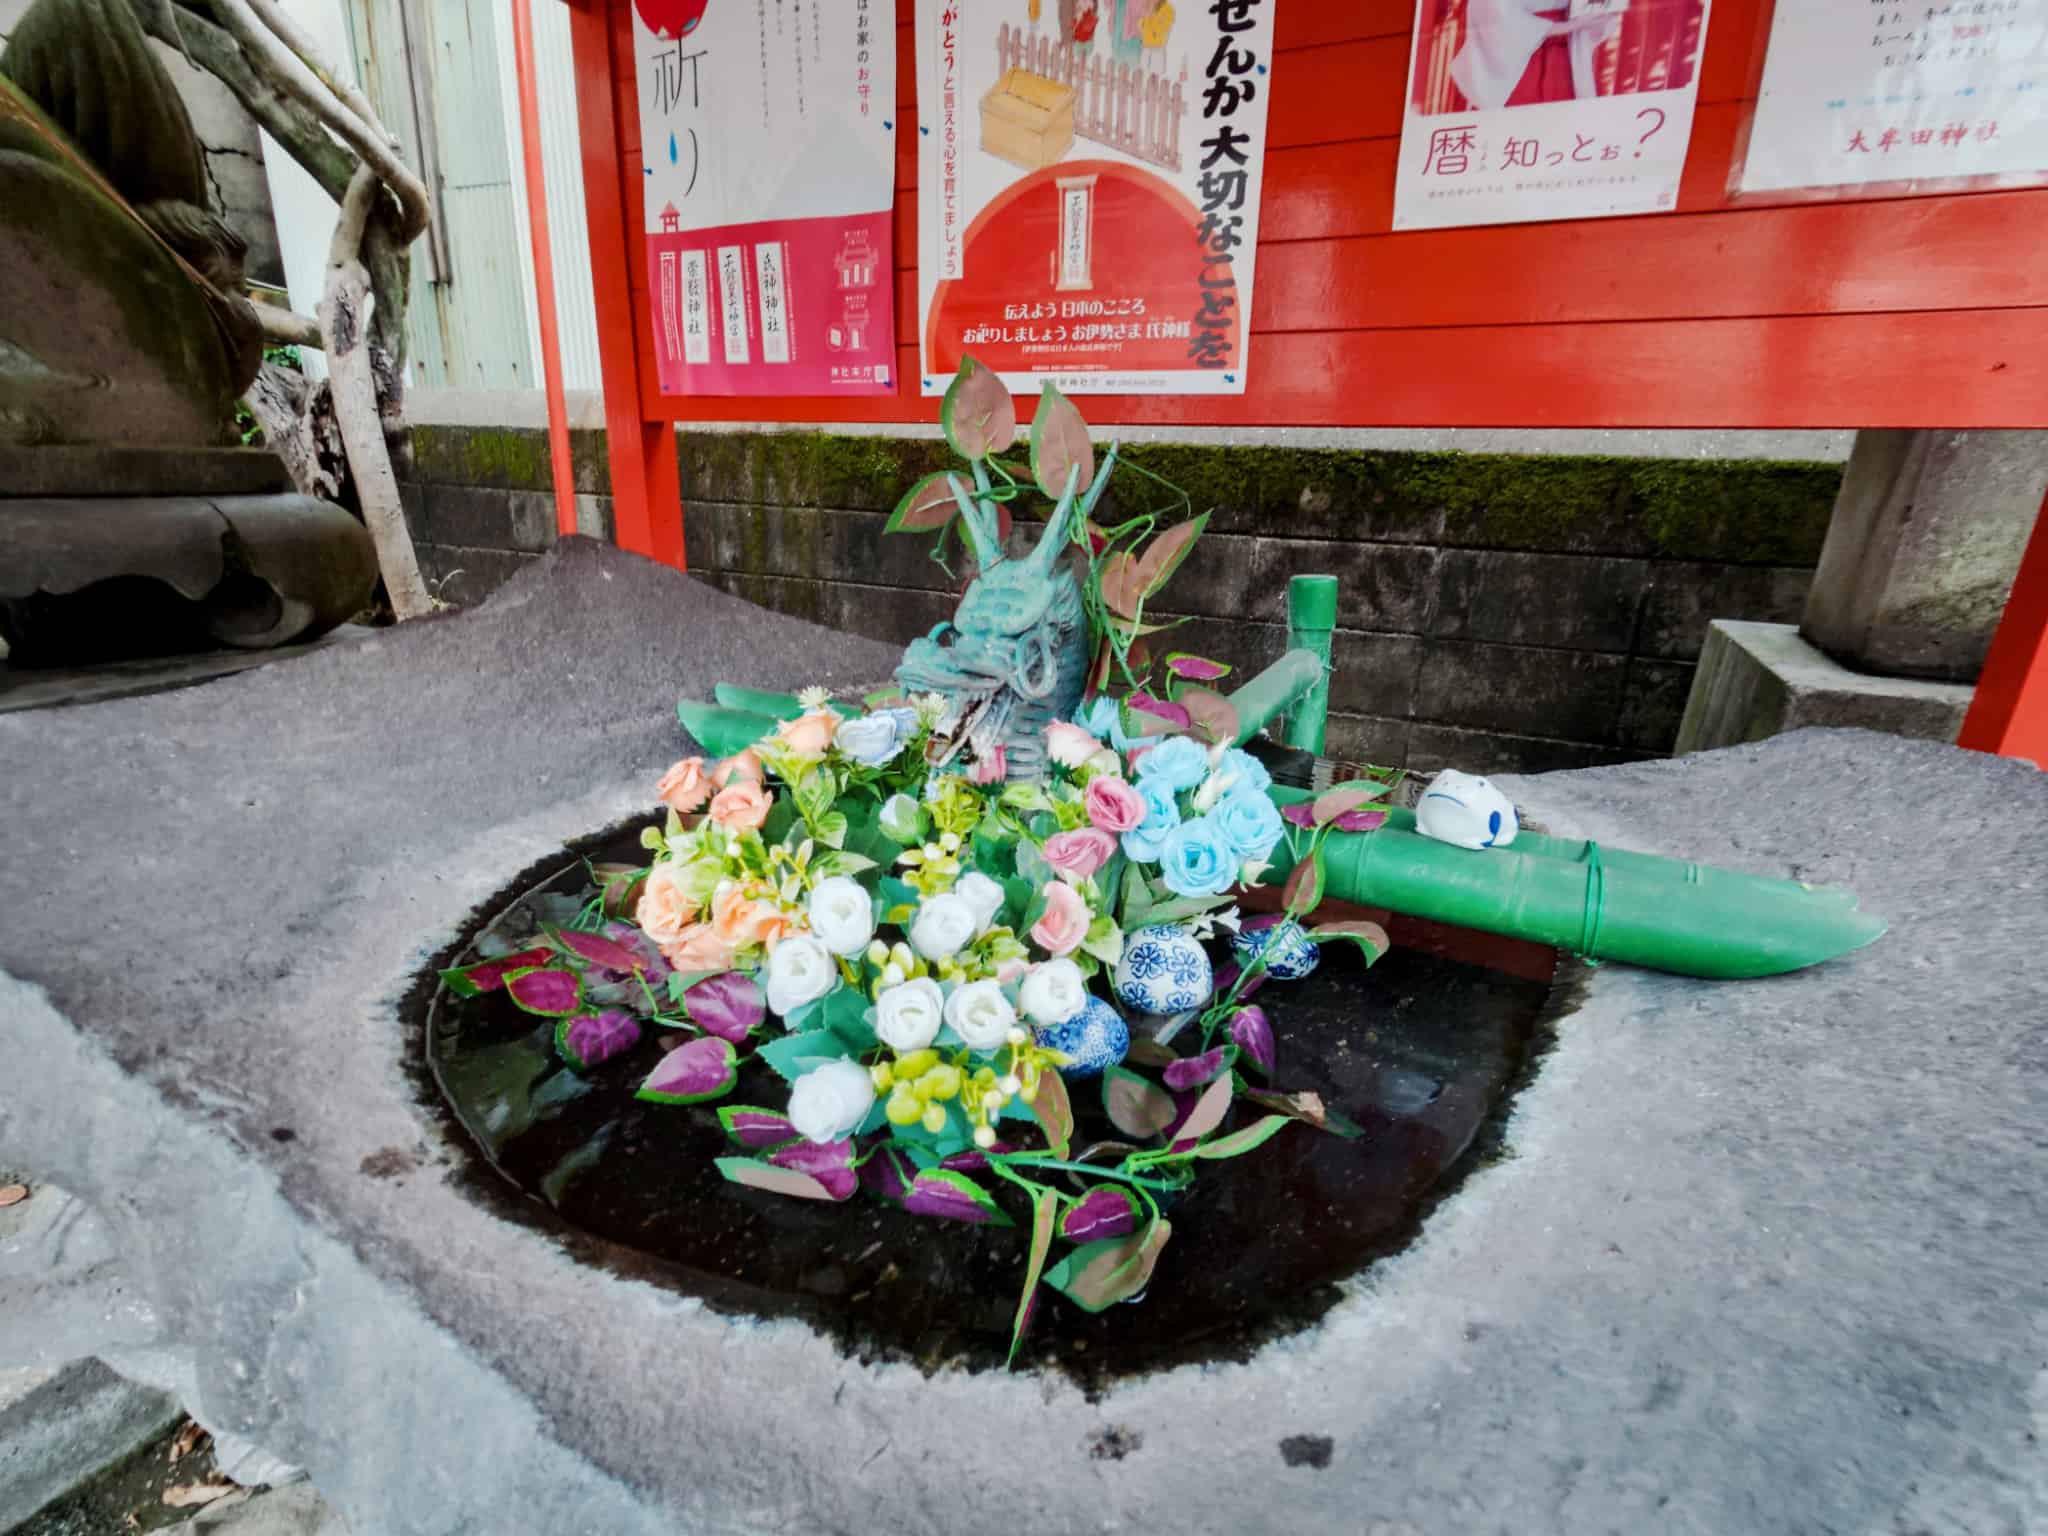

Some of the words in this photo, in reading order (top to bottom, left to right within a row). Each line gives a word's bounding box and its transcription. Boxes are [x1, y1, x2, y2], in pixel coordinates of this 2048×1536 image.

[1004, 303, 1057, 321] 伝えよう
[1061, 298, 1146, 318] 日本のこころ
